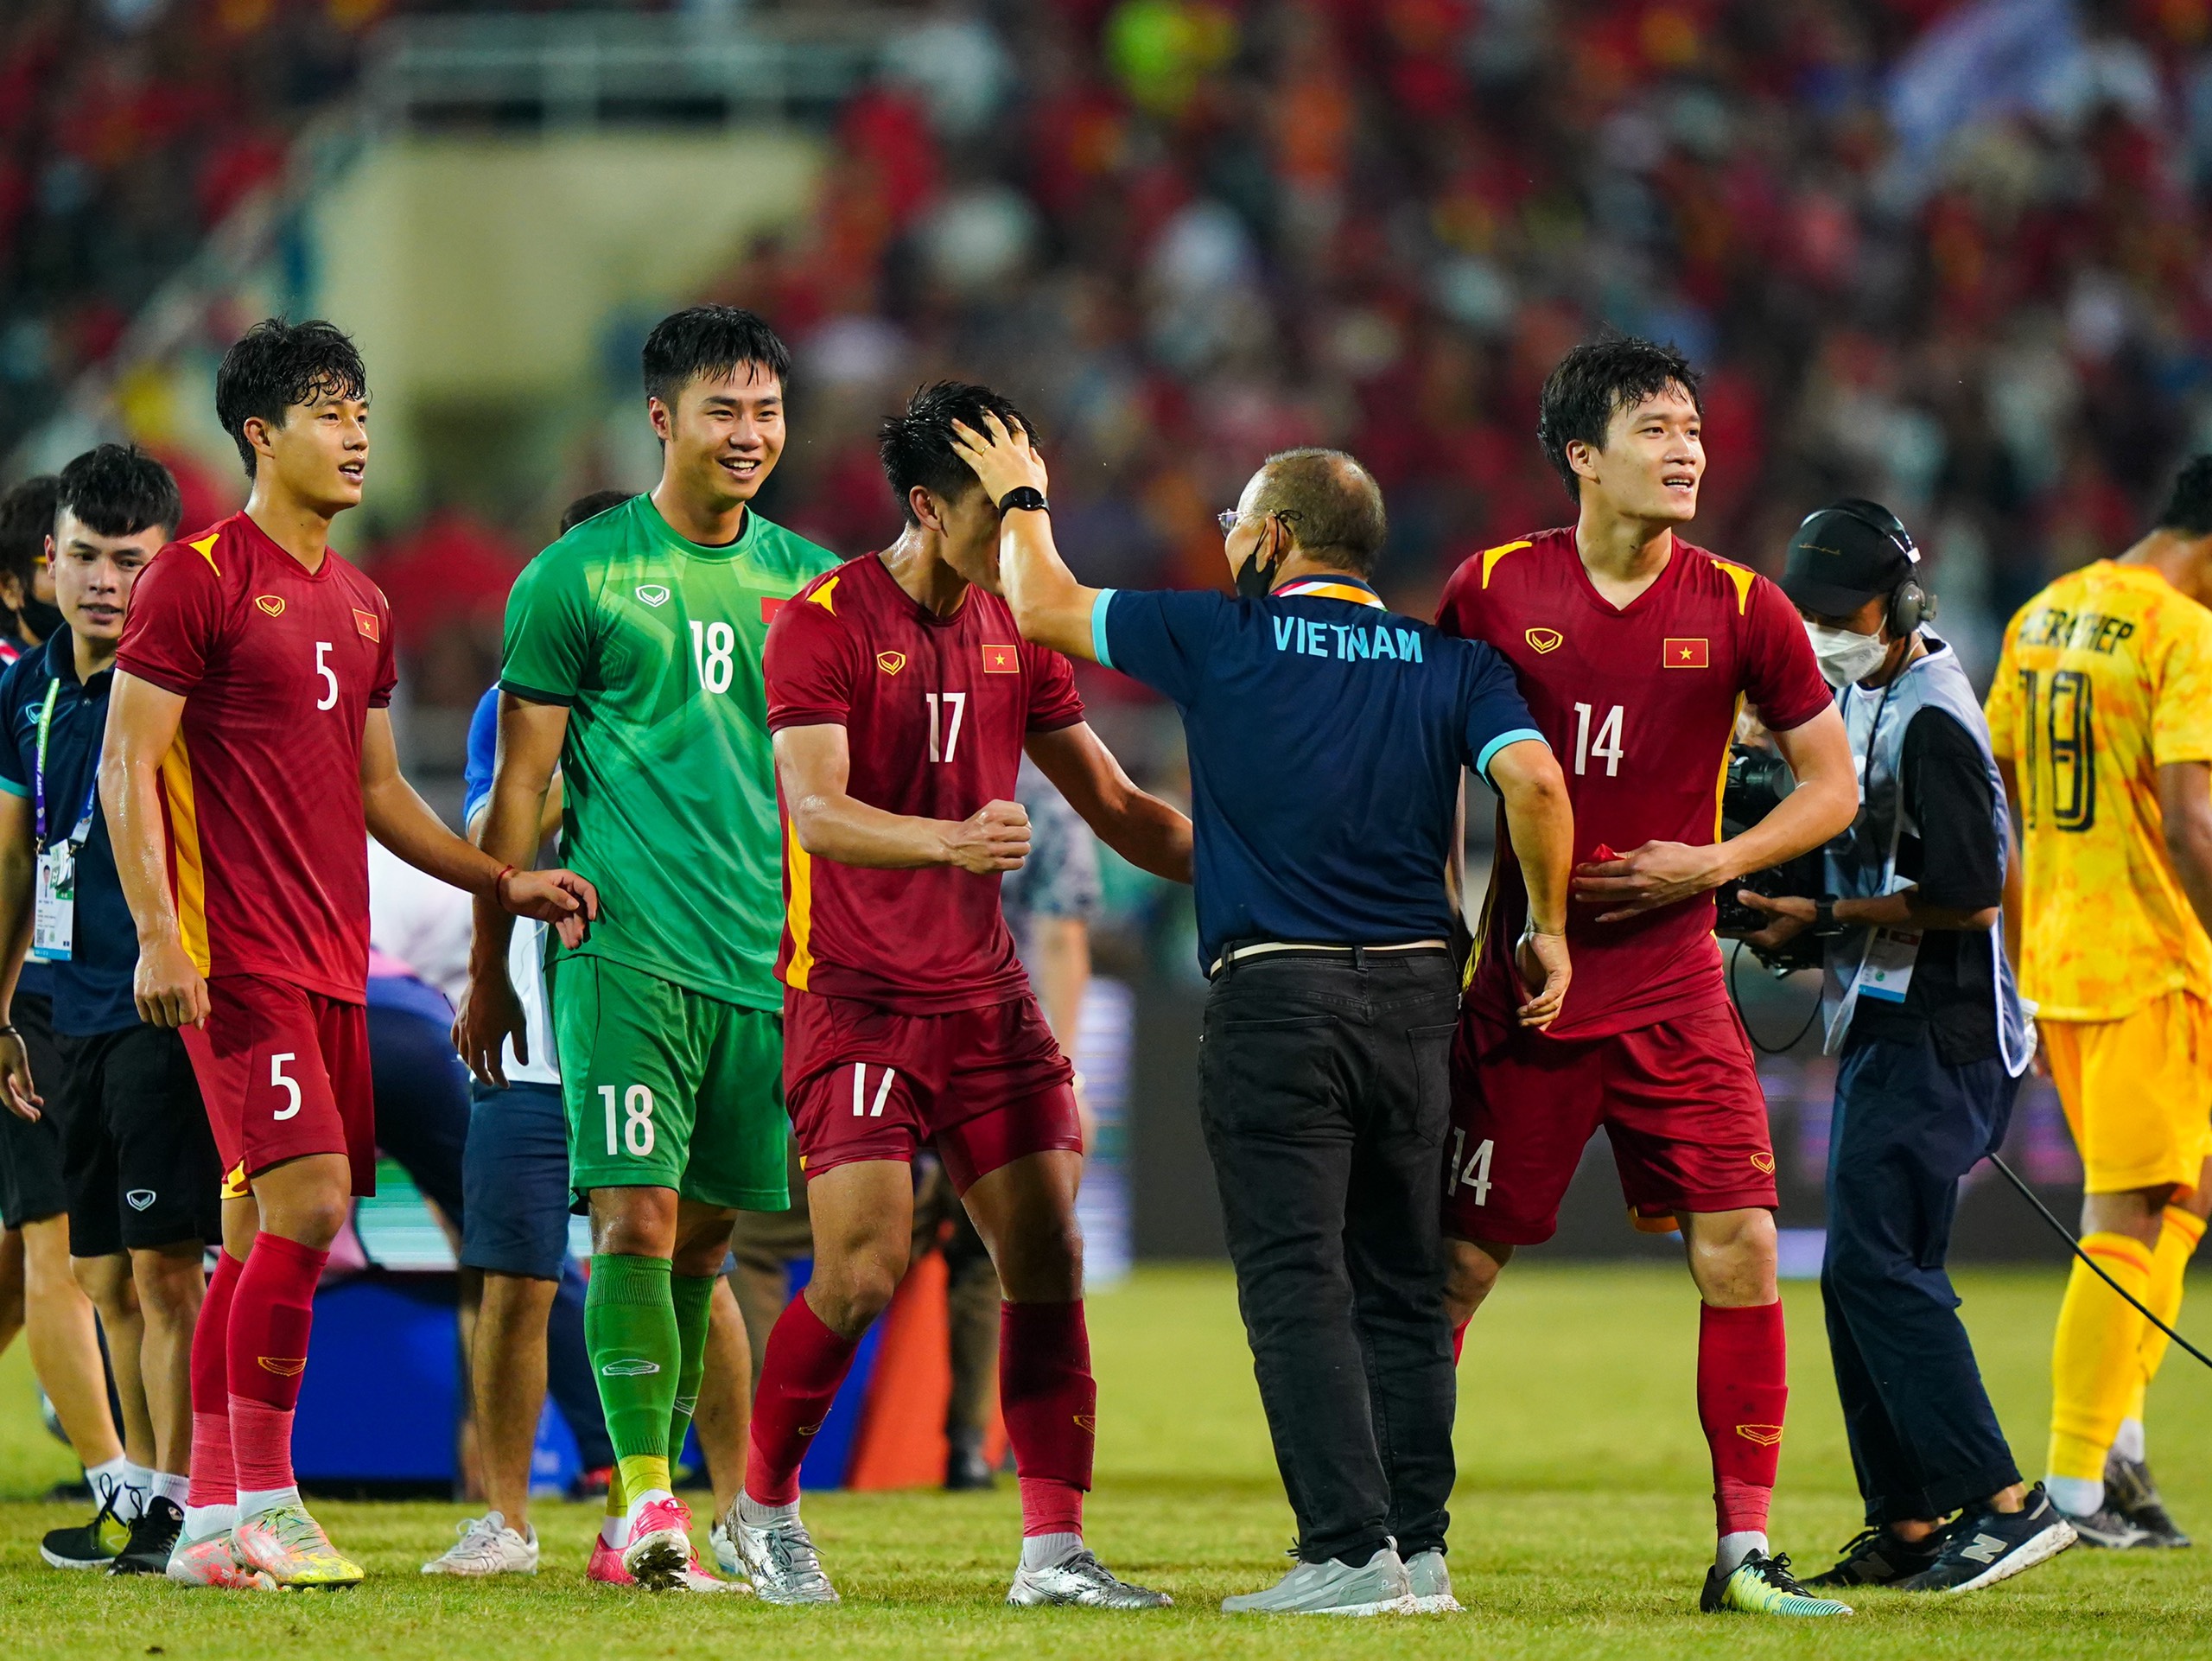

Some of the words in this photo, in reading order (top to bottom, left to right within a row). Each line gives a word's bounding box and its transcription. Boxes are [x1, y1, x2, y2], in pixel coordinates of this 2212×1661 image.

[689, 620, 735, 694] 18
[1273, 615, 1423, 663] VIETNAM
[315, 642, 338, 711] 5
[926, 692, 966, 763] 17
[1573, 703, 1624, 777] 14
[2018, 670, 2095, 832] 18
[270, 1053, 302, 1121] 5
[598, 1085, 654, 1156] 18
[853, 1062, 896, 1117] 17
[1448, 1127, 1494, 1206] 14
